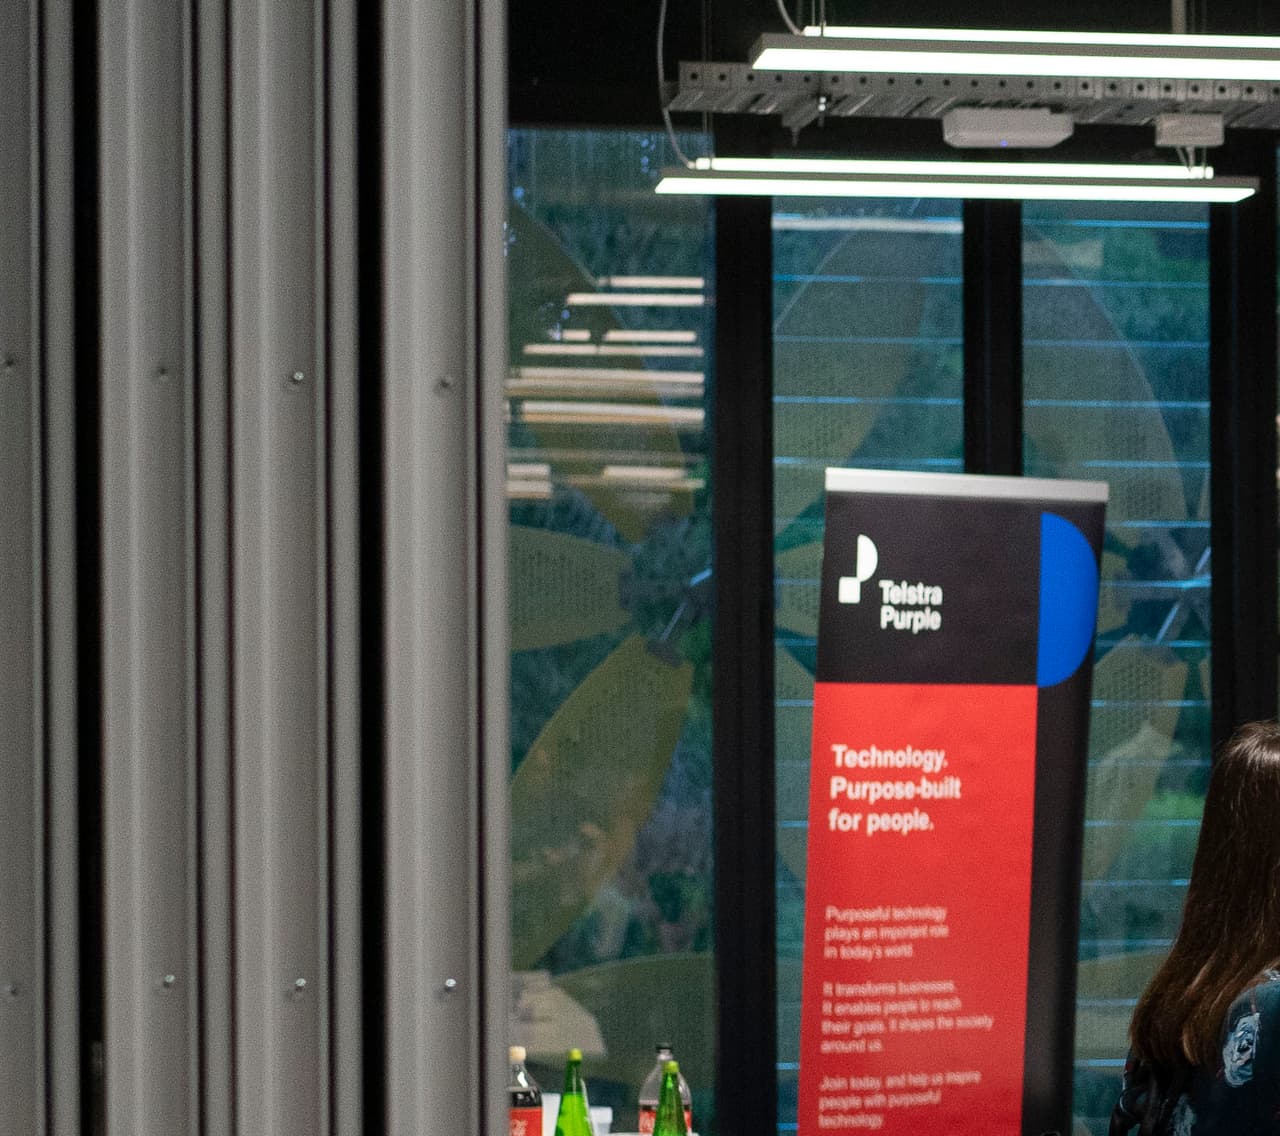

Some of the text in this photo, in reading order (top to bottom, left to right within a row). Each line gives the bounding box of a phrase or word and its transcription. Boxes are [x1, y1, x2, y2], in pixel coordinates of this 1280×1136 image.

[879, 580, 943, 606] Telstra
[880, 606, 942, 634] Purple
[831, 744, 948, 773] Technology.
[830, 776, 962, 805] Purpose-built
[829, 808, 934, 837] for people.
[825, 926, 860, 942] plays
[862, 927, 877, 940] an
[880, 924, 929, 941] important
[835, 980, 897, 997] transforms
[834, 1000, 881, 1015] enables
[884, 998, 918, 1016] people
[821, 1018, 851, 1034] their
[899, 1017, 936, 1033] shapes
[820, 1039, 866, 1054] around
[885, 1073, 907, 1089] and
[818, 1095, 862, 1112] people
[863, 1093, 887, 1109] with
